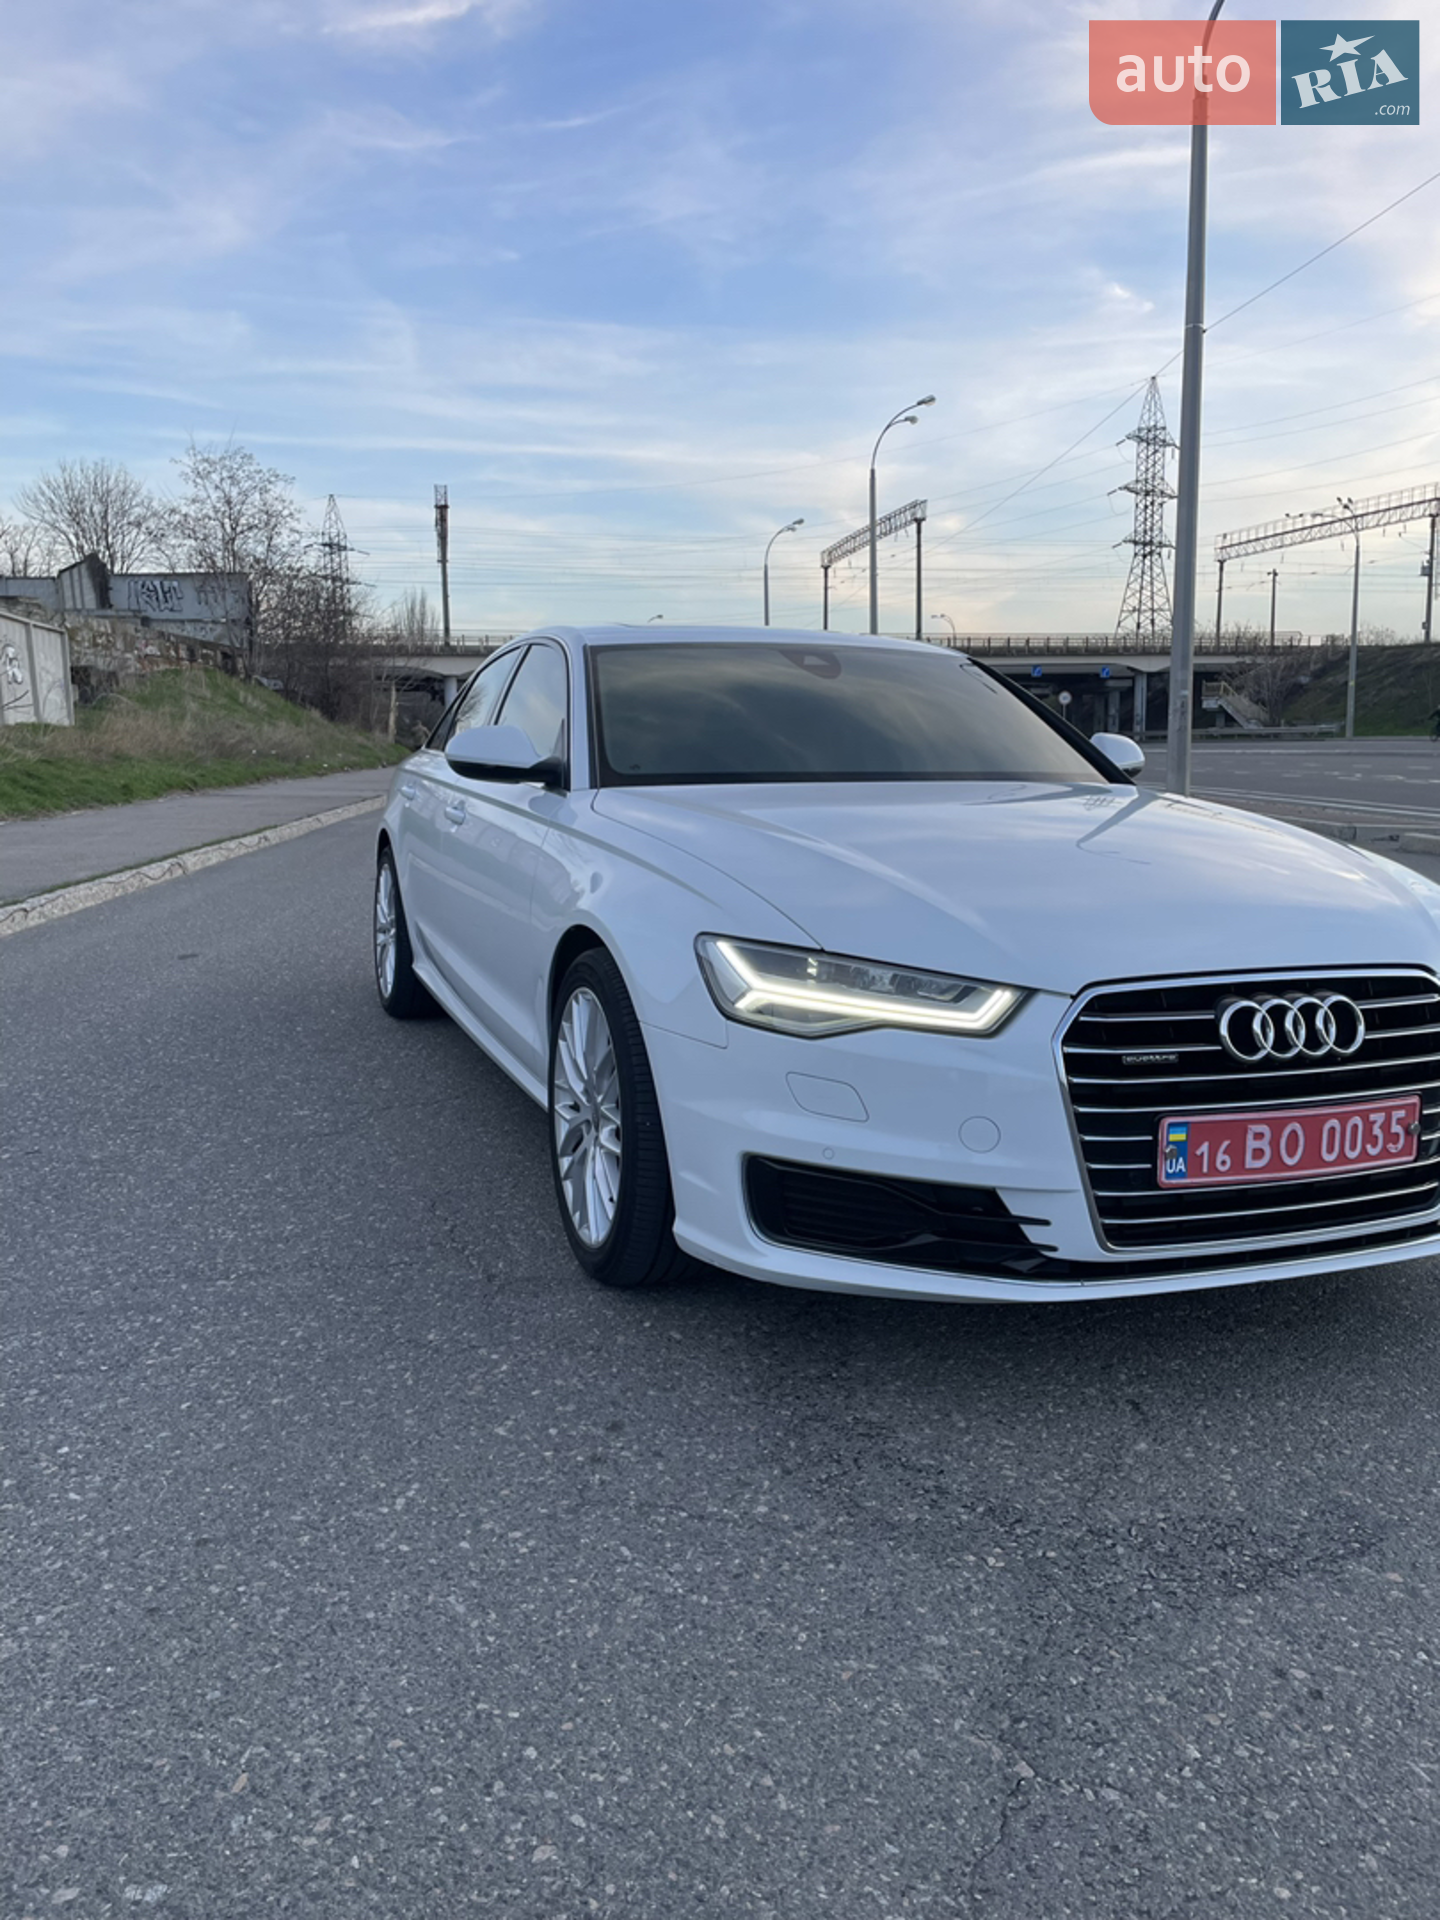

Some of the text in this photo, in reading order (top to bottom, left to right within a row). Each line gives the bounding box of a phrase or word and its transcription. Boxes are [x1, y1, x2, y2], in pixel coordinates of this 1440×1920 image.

[1195, 1110, 1406, 1174] 16 BO 0035
[1166, 1156, 1187, 1174] UA
